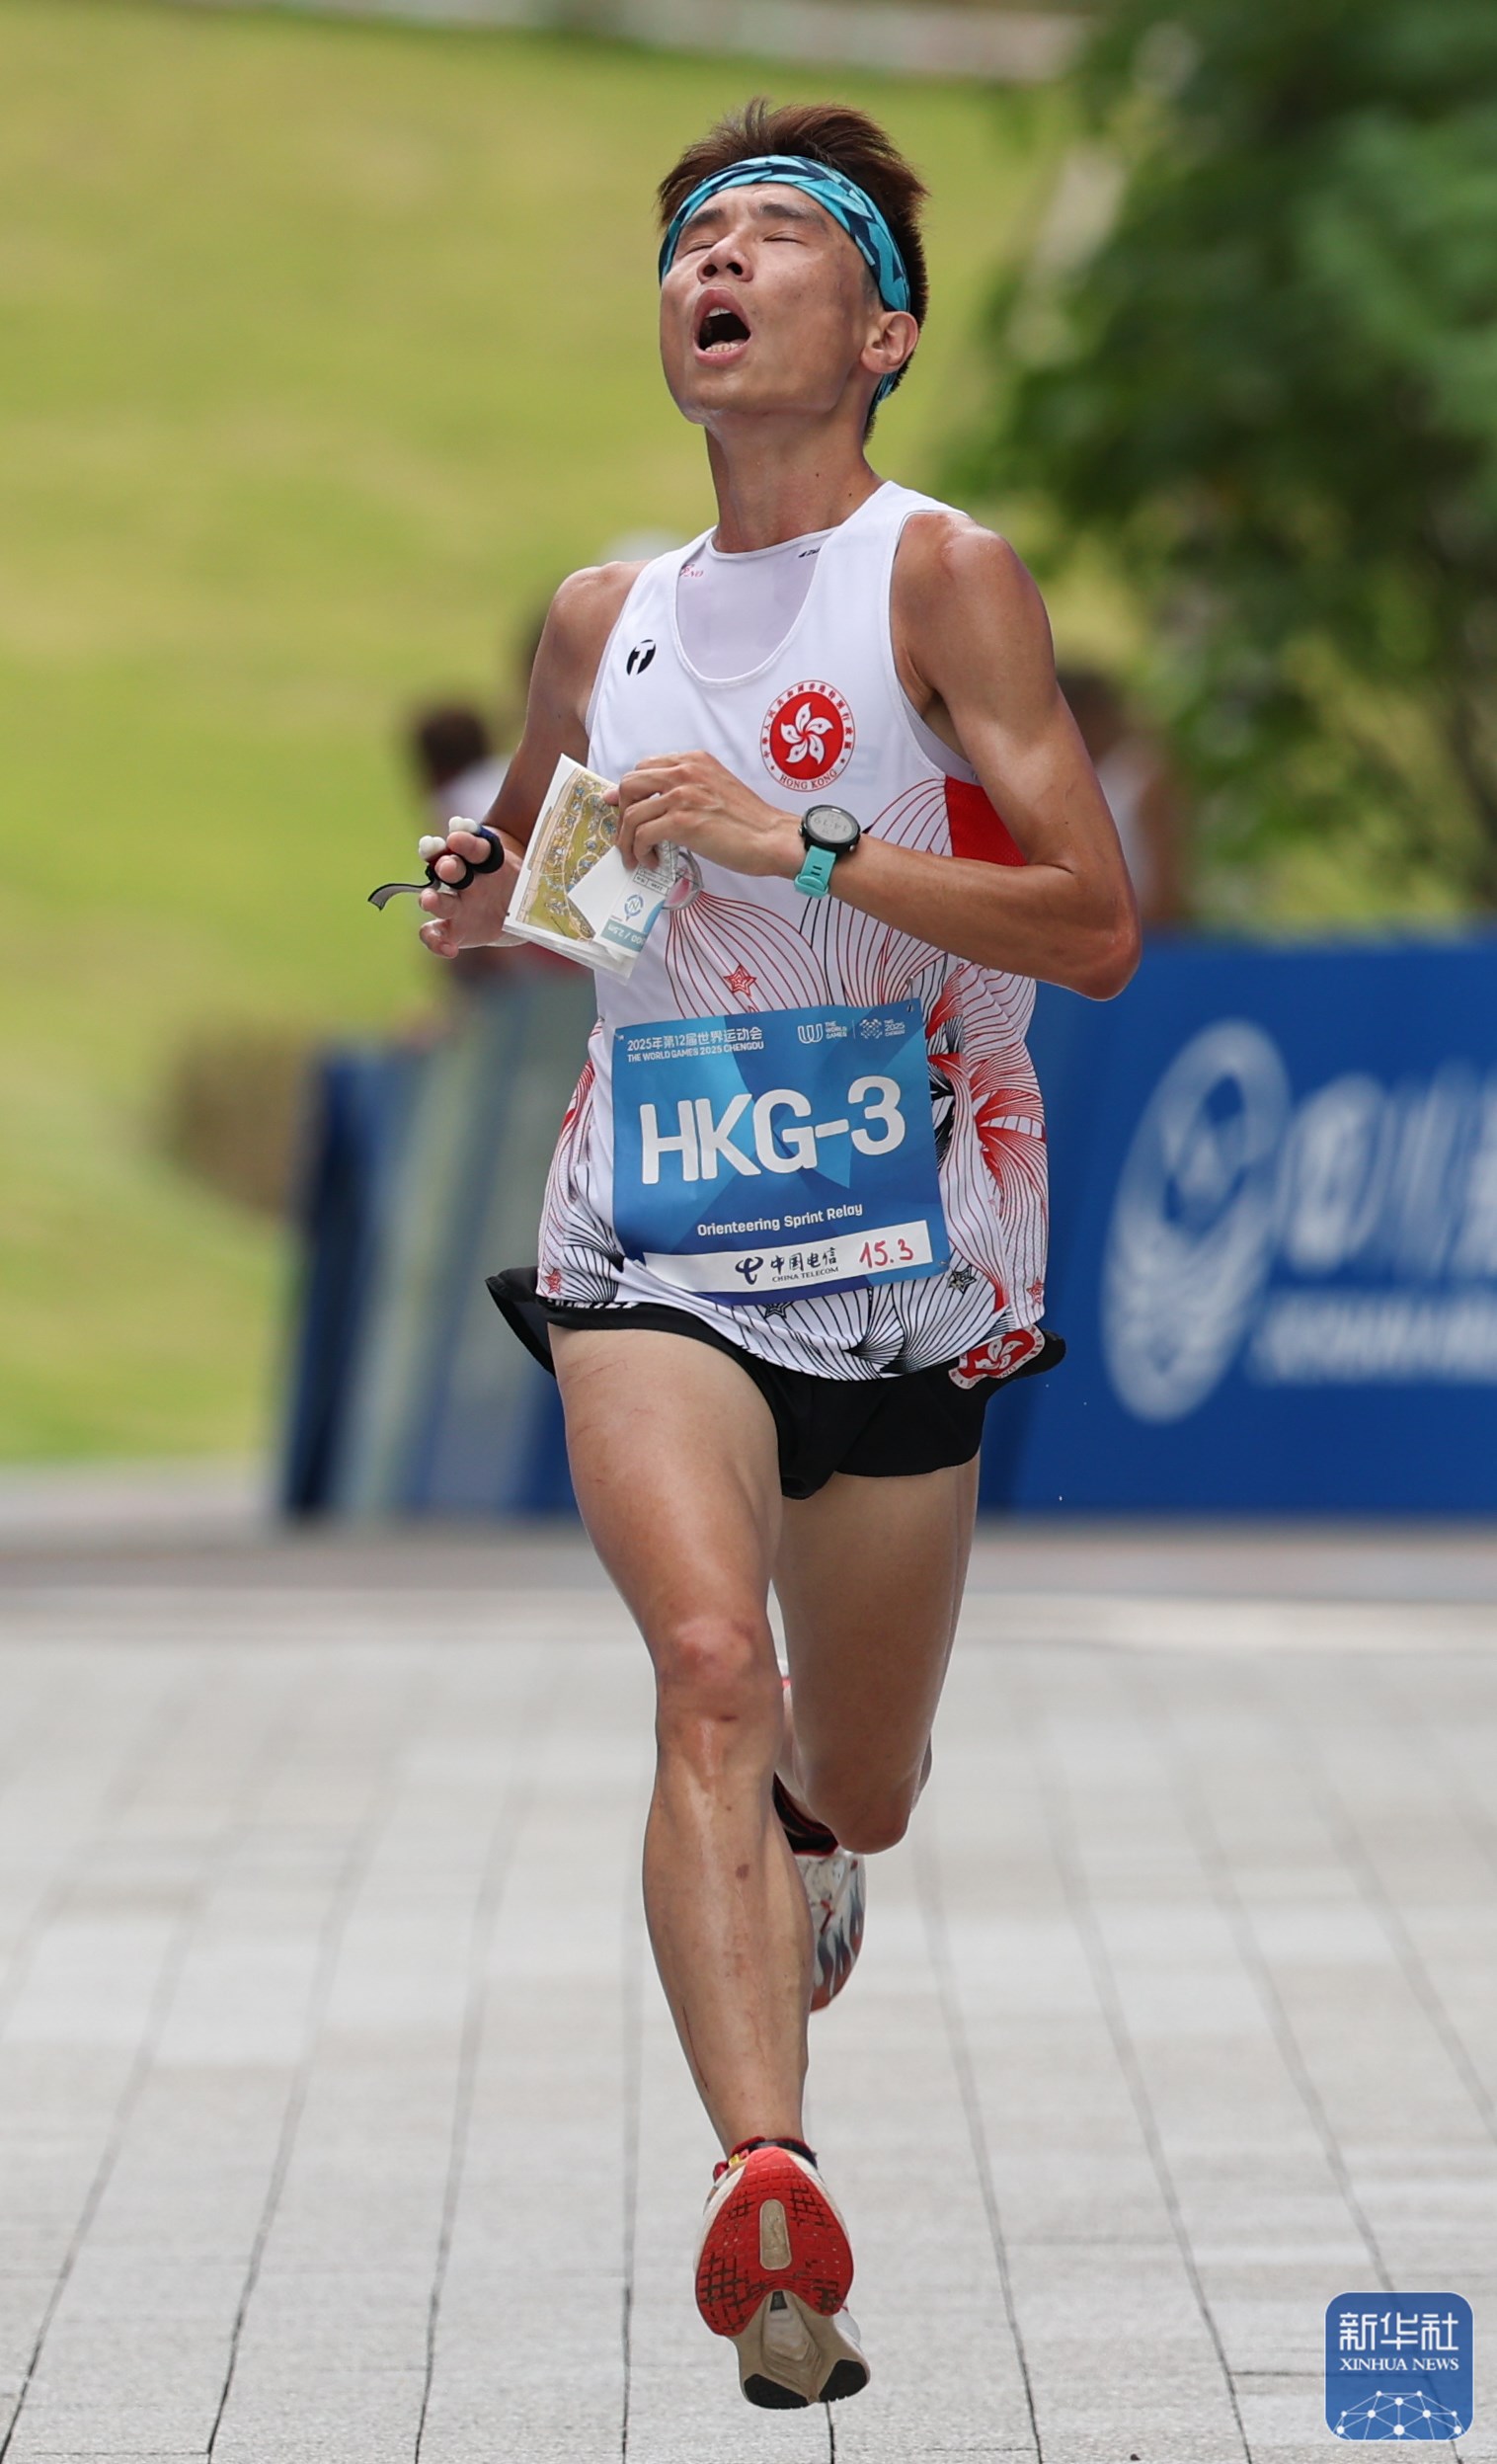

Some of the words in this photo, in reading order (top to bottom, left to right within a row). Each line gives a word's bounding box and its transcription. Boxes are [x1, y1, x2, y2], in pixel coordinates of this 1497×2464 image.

[780, 774, 808, 789] HONG
[811, 769, 837, 789] KONG
[627, 1026, 762, 1052] 2025年第12届世界运动会
[627, 1054, 641, 1063] THE
[643, 1051, 670, 1062] WORLD
[671, 1047, 699, 1059] GAMES
[700, 1046, 723, 1056] 2025
[724, 1041, 764, 1053] CHENGDU
[639, 1075, 906, 1185] HKG-3
[697, 1218, 780, 1236] Orienteering
[784, 1210, 824, 1229] Sprint
[827, 1203, 863, 1221] Relay
[770, 1246, 837, 1276] 中国电信
[859, 1238, 913, 1268] 15.3
[772, 1274, 799, 1283] CHINA
[801, 1266, 839, 1279] TELECOM
